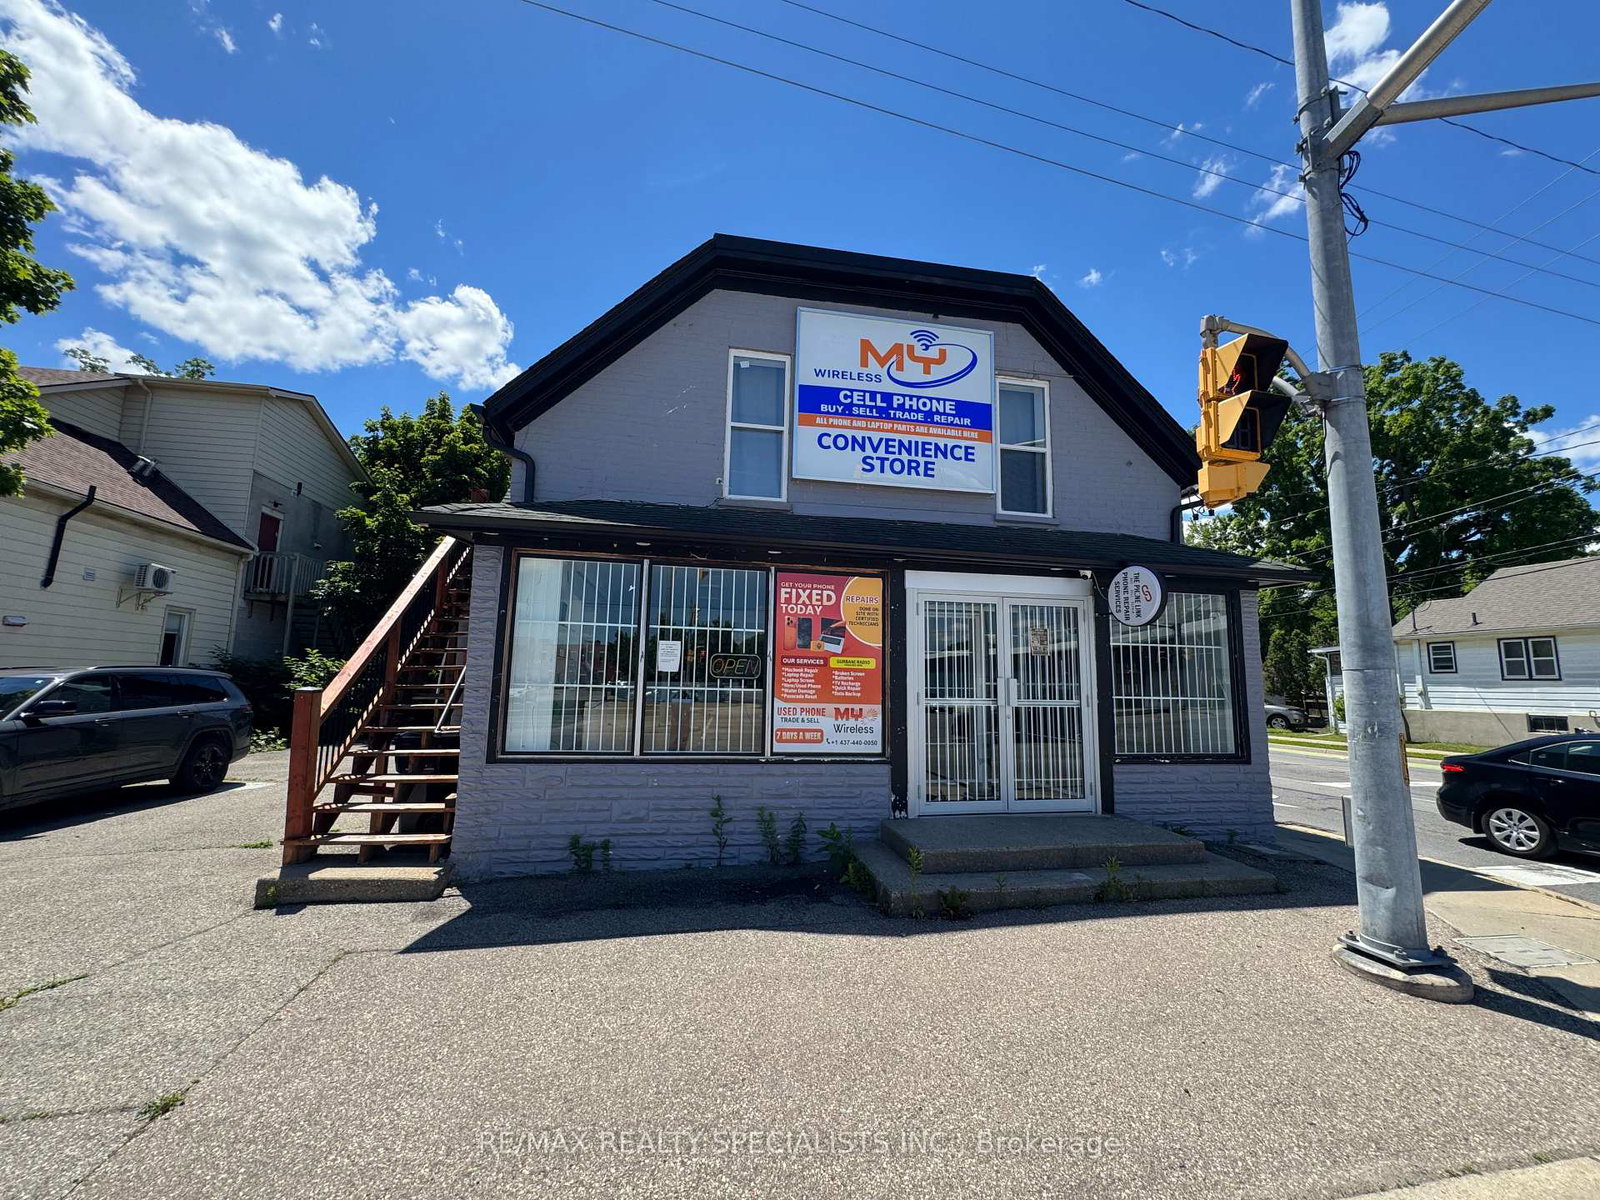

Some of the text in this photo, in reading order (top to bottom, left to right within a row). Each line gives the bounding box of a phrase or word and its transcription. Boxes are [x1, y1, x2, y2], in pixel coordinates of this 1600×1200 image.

[860, 338, 946, 375] MY
[814, 368, 882, 384] WIRELESS
[839, 390, 956, 414] CELL PHONE
[829, 418, 851, 426] PHONE
[852, 420, 867, 428] AND
[868, 420, 892, 430] LAPTOP
[894, 423, 915, 432] PARTS
[929, 427, 962, 437] AVAILABLE
[963, 430, 978, 439] HERE
[934, 415, 971, 426] REPAIR
[817, 432, 976, 462] CONVENIENCE
[862, 455, 936, 478] STORE
[780, 588, 836, 605] FIXED
[846, 595, 879, 604] REPAIRS
[780, 604, 823, 615] TODAY
[712, 658, 759, 674] OPEN
[777, 707, 826, 717] USED PHONE
[834, 707, 863, 721] MY
[833, 723, 874, 734] Wireless
